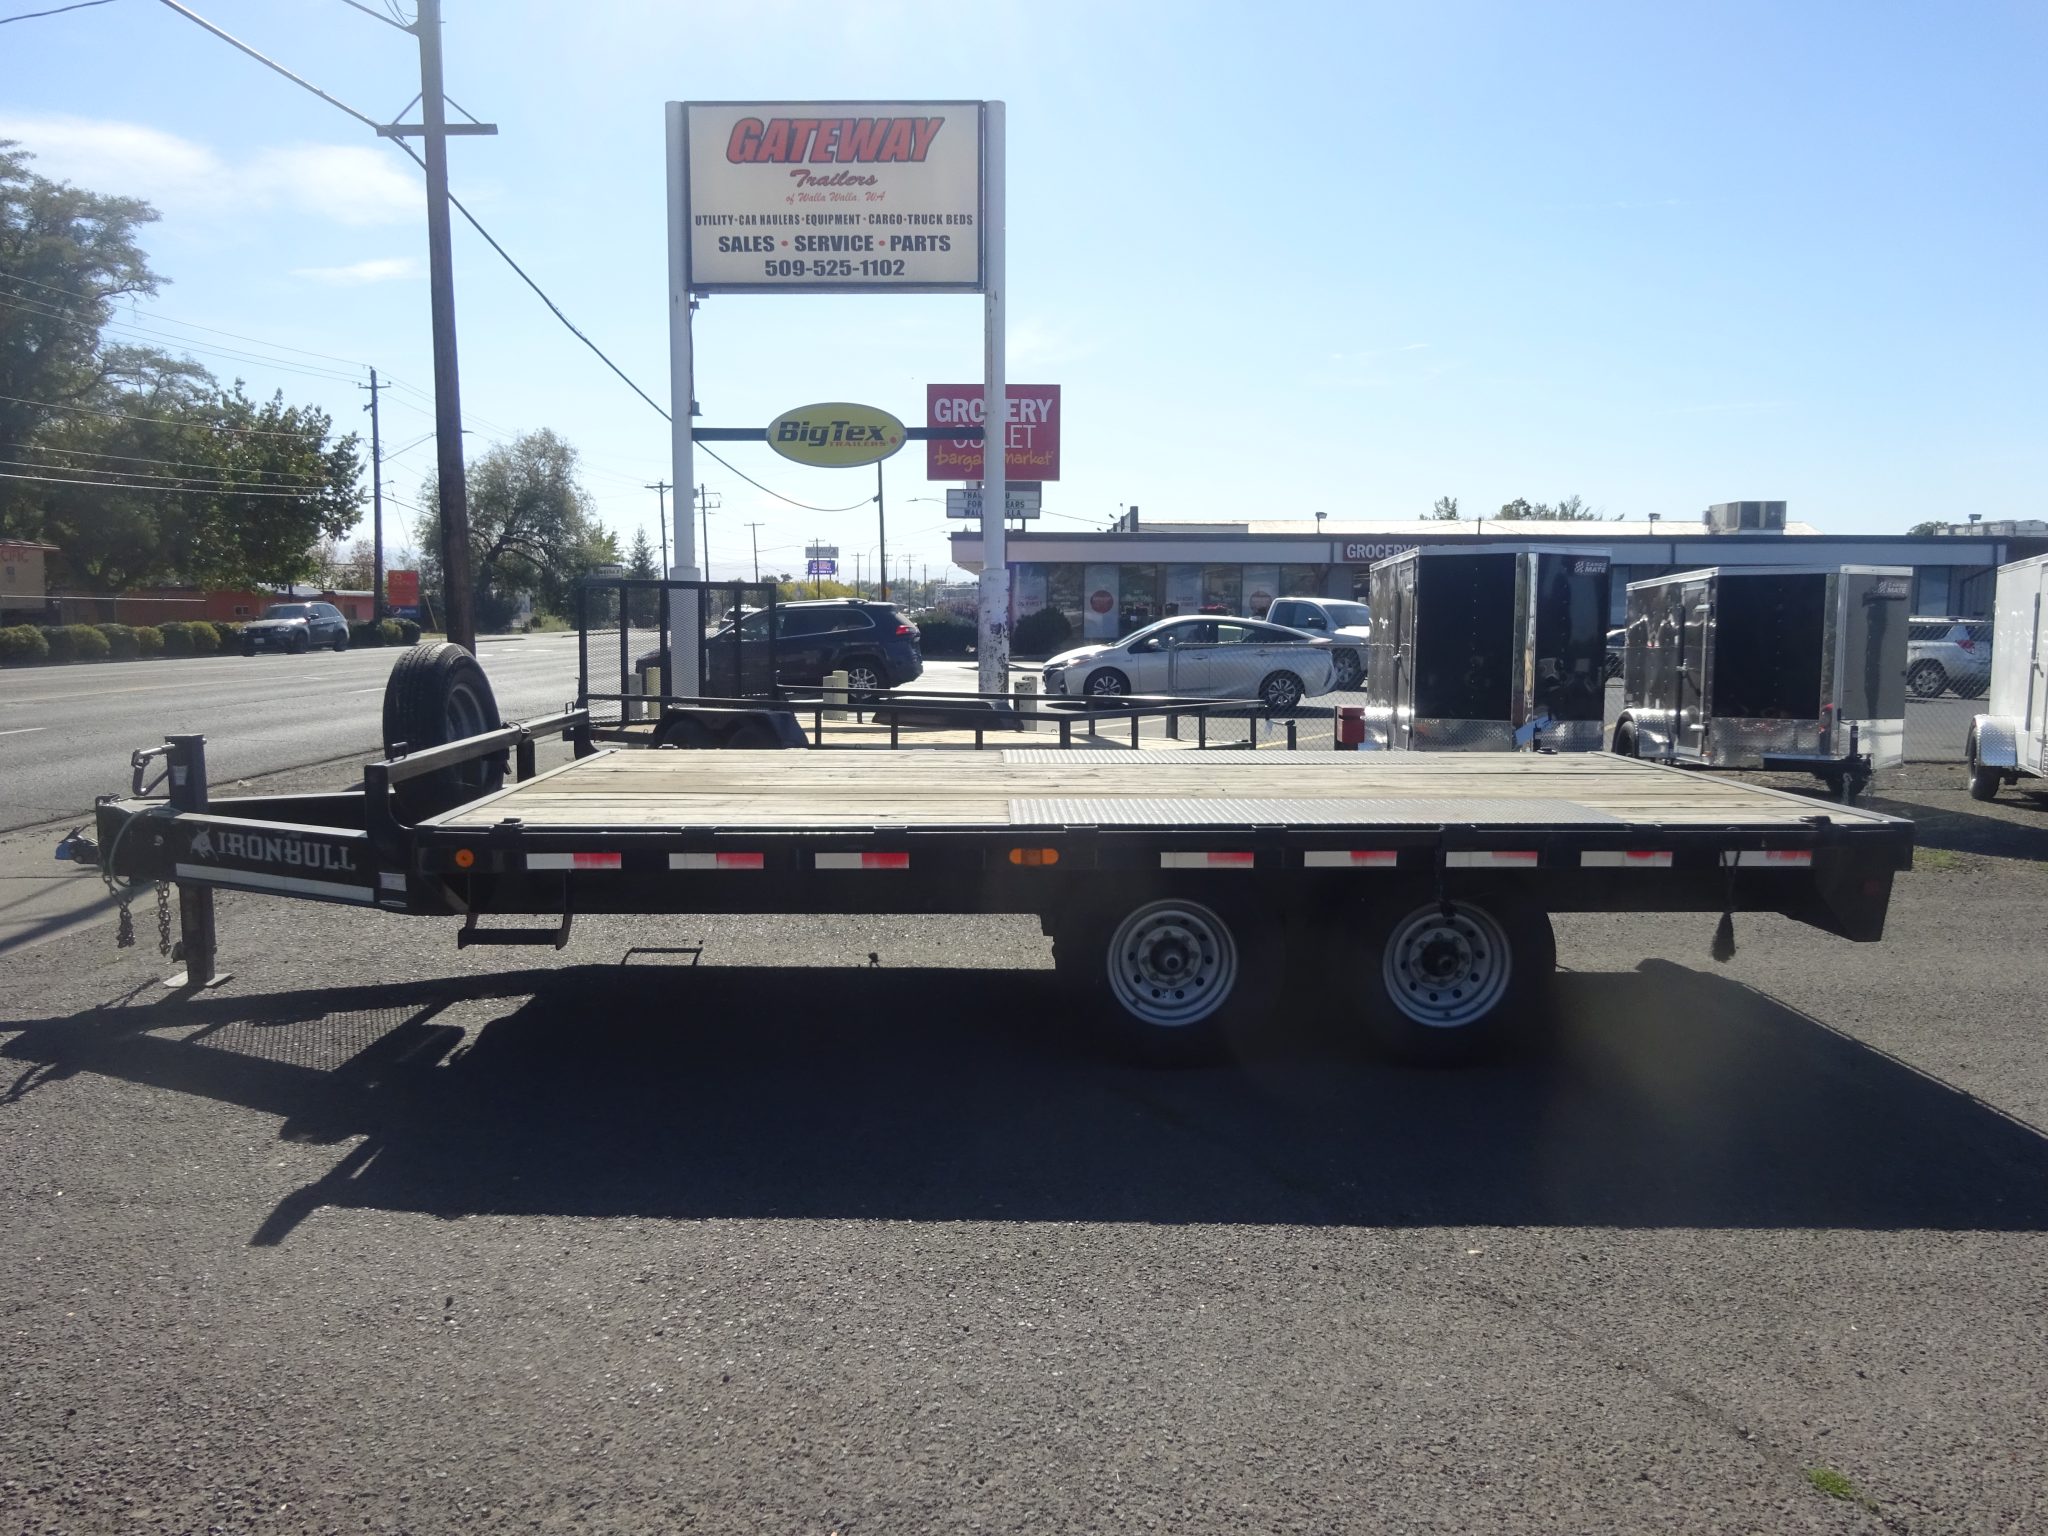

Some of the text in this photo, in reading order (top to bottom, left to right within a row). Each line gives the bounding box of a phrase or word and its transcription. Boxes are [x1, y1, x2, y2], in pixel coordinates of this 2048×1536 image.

[726, 117, 945, 164] GATEWAY
[790, 169, 878, 188] Trailers
[785, 193, 795, 205] of
[797, 192, 826, 202] Walla
[865, 190, 886, 201] WA
[695, 213, 973, 226] UTILITY CAR HAULERS EQUIPMENT CARGO TRUCK BEDS
[718, 235, 951, 252] SALES SERVICE PARTS
[765, 259, 905, 277] 509-525-1102
[934, 398, 1053, 422] GROERY
[829, 441, 888, 449] TRAILERS
[1005, 500, 1025, 508] EARS
[217, 831, 357, 871] IRONBULL
